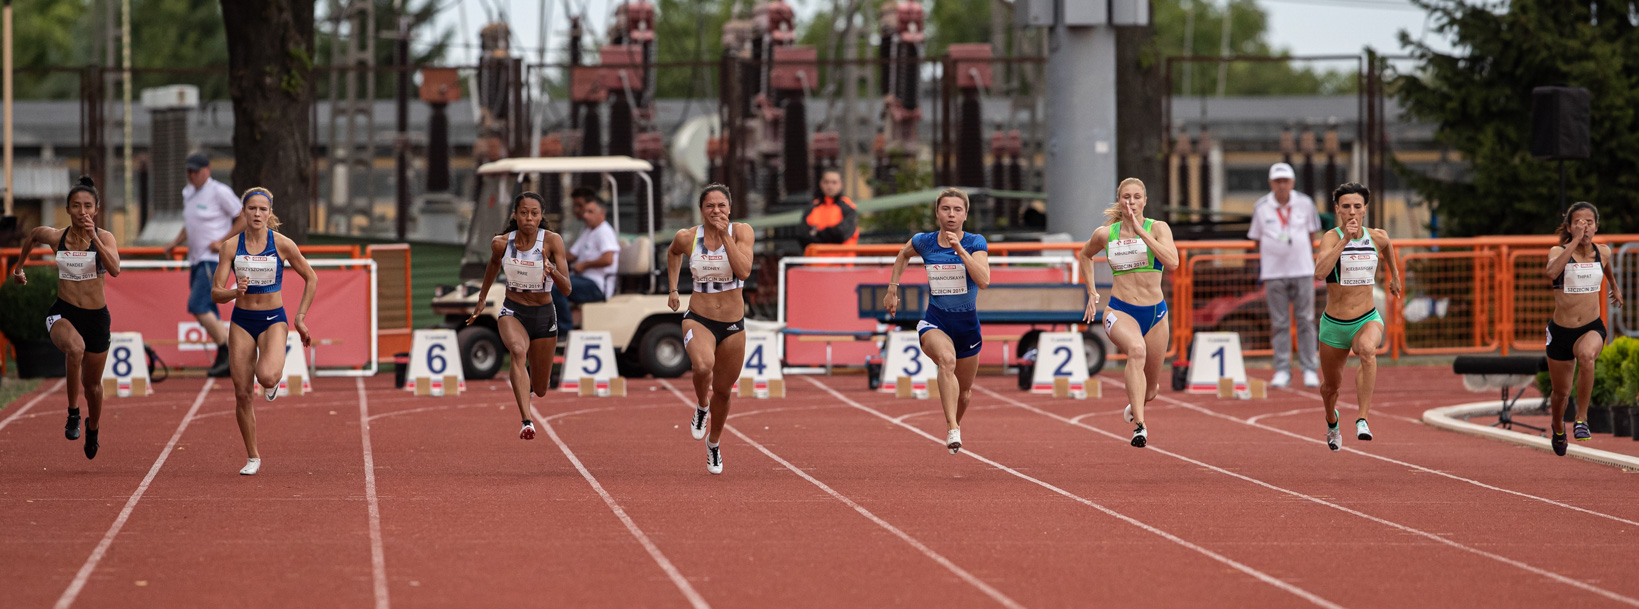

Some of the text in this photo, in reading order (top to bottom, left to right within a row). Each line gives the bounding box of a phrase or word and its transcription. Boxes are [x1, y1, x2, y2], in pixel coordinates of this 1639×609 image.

[112, 346, 133, 377] 8
[426, 343, 447, 375] 6
[582, 344, 602, 375] 5
[745, 344, 767, 375] 4
[903, 345, 922, 376] 3
[1053, 346, 1073, 376] 2
[1210, 346, 1225, 377] 1
